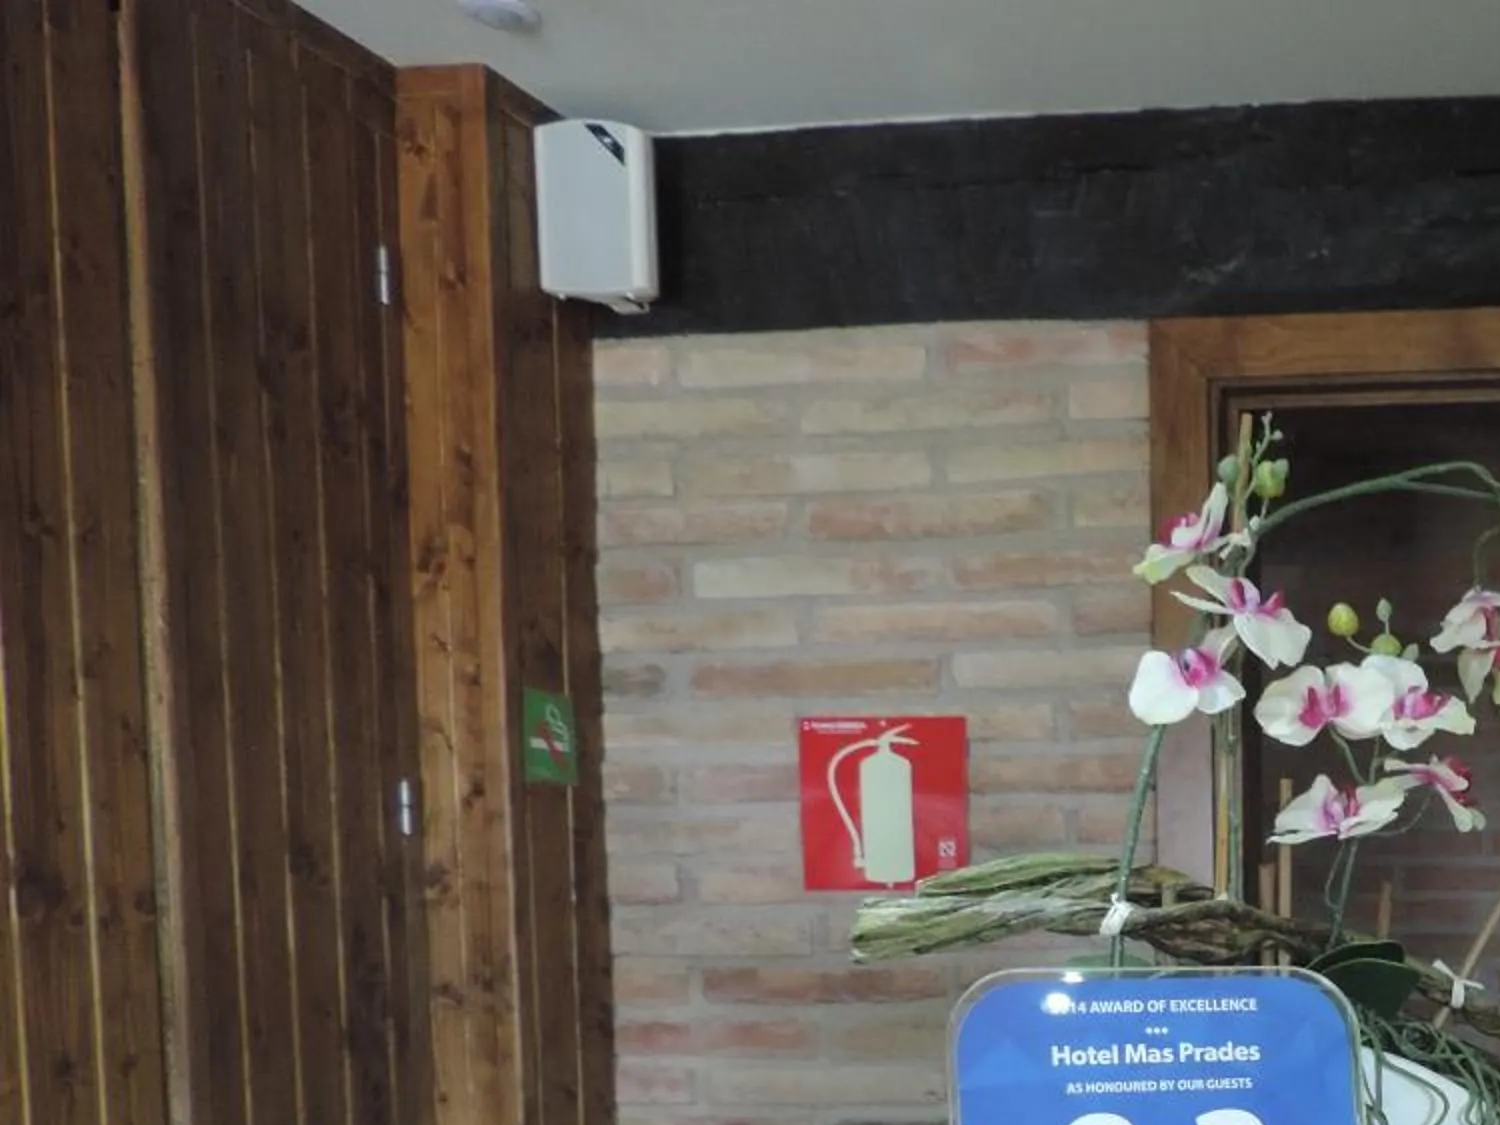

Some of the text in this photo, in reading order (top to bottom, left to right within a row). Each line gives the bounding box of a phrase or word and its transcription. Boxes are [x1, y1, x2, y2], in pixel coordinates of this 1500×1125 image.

[1089, 1000, 1144, 1014] AWARD
[1147, 1000, 1166, 1012] OF
[1170, 998, 1258, 1012] EXCELLENCE
[1051, 1041, 1261, 1066] Hotel Mas Prades
[1066, 1077, 1253, 1094] AS HONOURED BY OUR GUESTS
